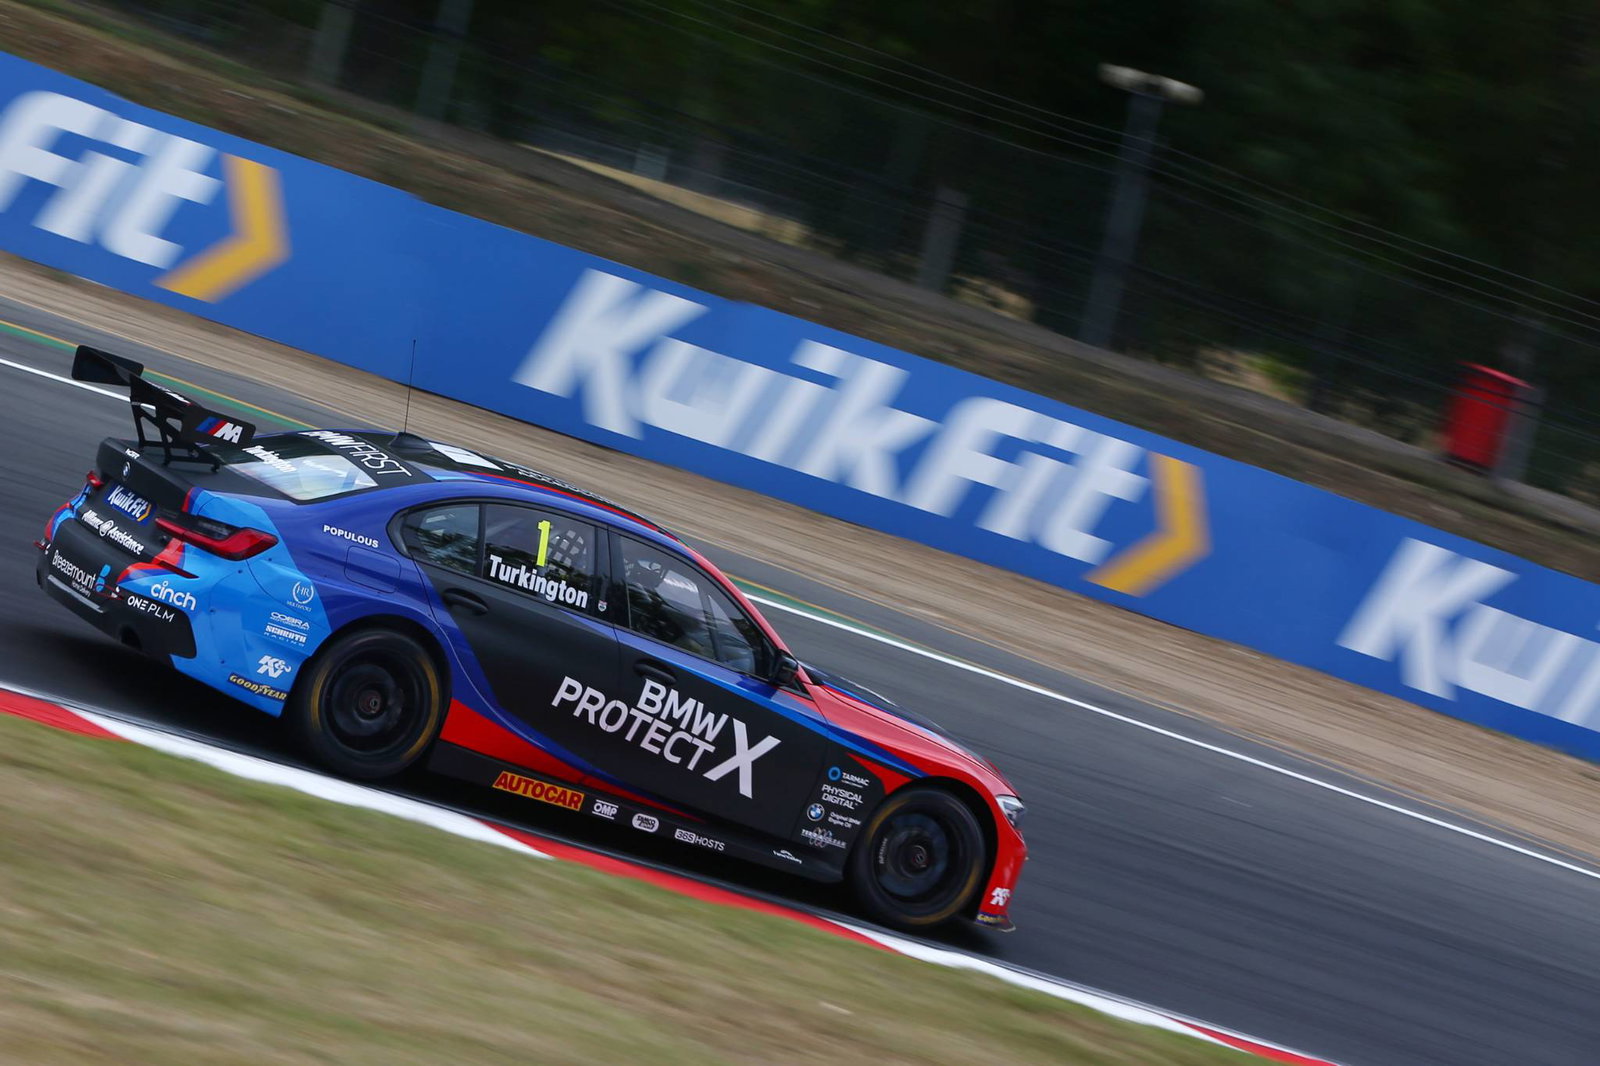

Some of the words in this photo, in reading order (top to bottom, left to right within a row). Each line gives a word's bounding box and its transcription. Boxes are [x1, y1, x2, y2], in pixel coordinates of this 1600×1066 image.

[339, 444, 412, 477] FIRST
[107, 526, 144, 555] Assistance
[323, 524, 379, 548] POPULOUS
[536, 520, 551, 567] 1
[150, 581, 196, 610] cinch
[490, 554, 588, 608] Turkington
[127, 596, 149, 611] ONE
[147, 604, 175, 623] PLM
[271, 611, 310, 631] COBRA
[265, 625, 307, 644] SCHROTH
[230, 675, 287, 700] GOODYEAR
[551, 676, 716, 771] PROTECT
[637, 678, 729, 742] BMW
[703, 717, 782, 799] X
[495, 773, 583, 809] AUTOCAR
[842, 772, 869, 786] TARMAC
[822, 784, 863, 804] PHYSICAL
[593, 803, 617, 816] OMP
